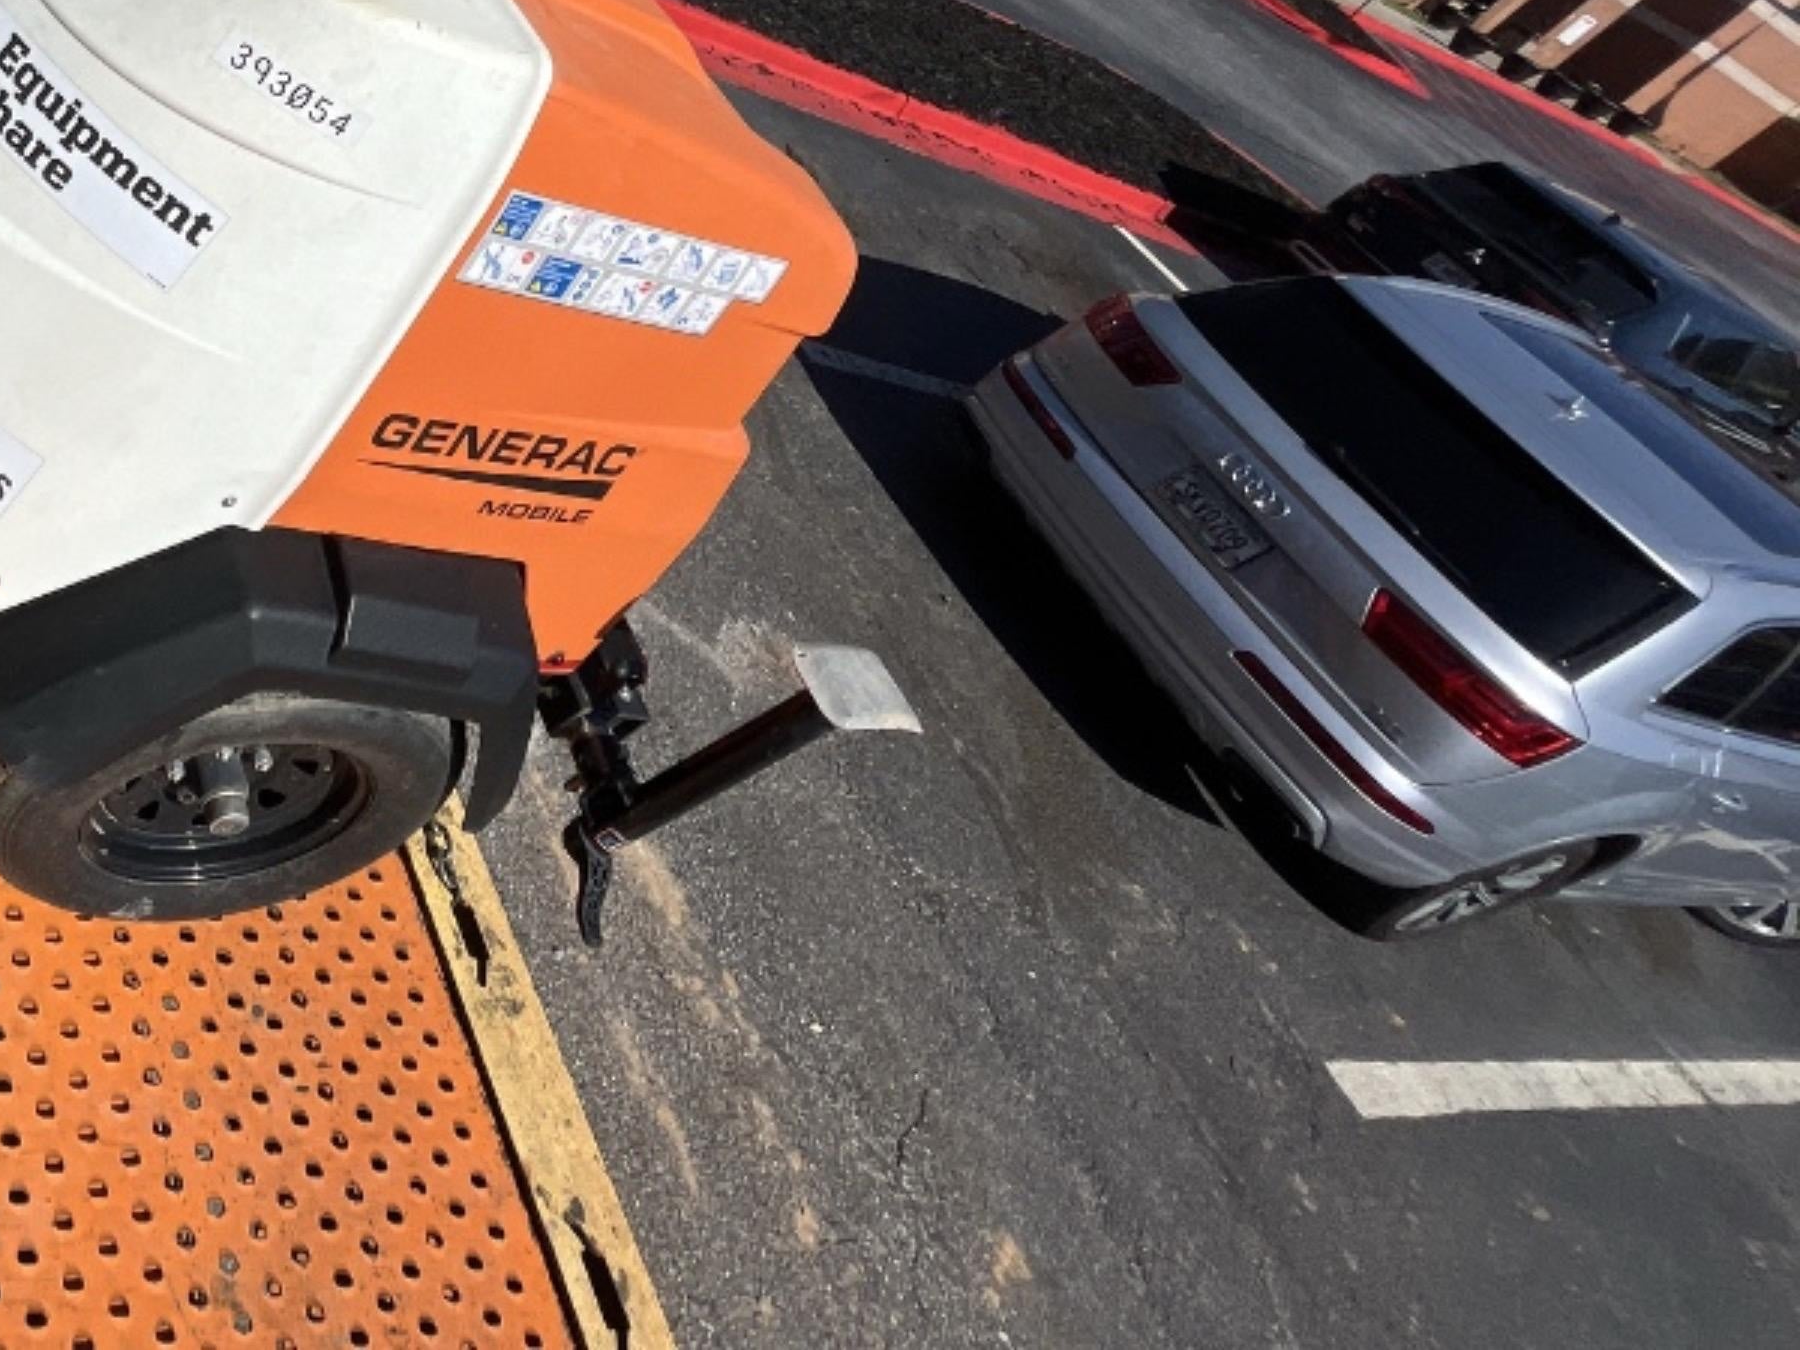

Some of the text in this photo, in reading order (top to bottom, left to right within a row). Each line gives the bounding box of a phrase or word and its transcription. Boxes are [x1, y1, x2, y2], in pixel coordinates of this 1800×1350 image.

[228, 42, 353, 138] 393054
[370, 412, 636, 477] GENERAC
[477, 499, 595, 525] MOBILE
